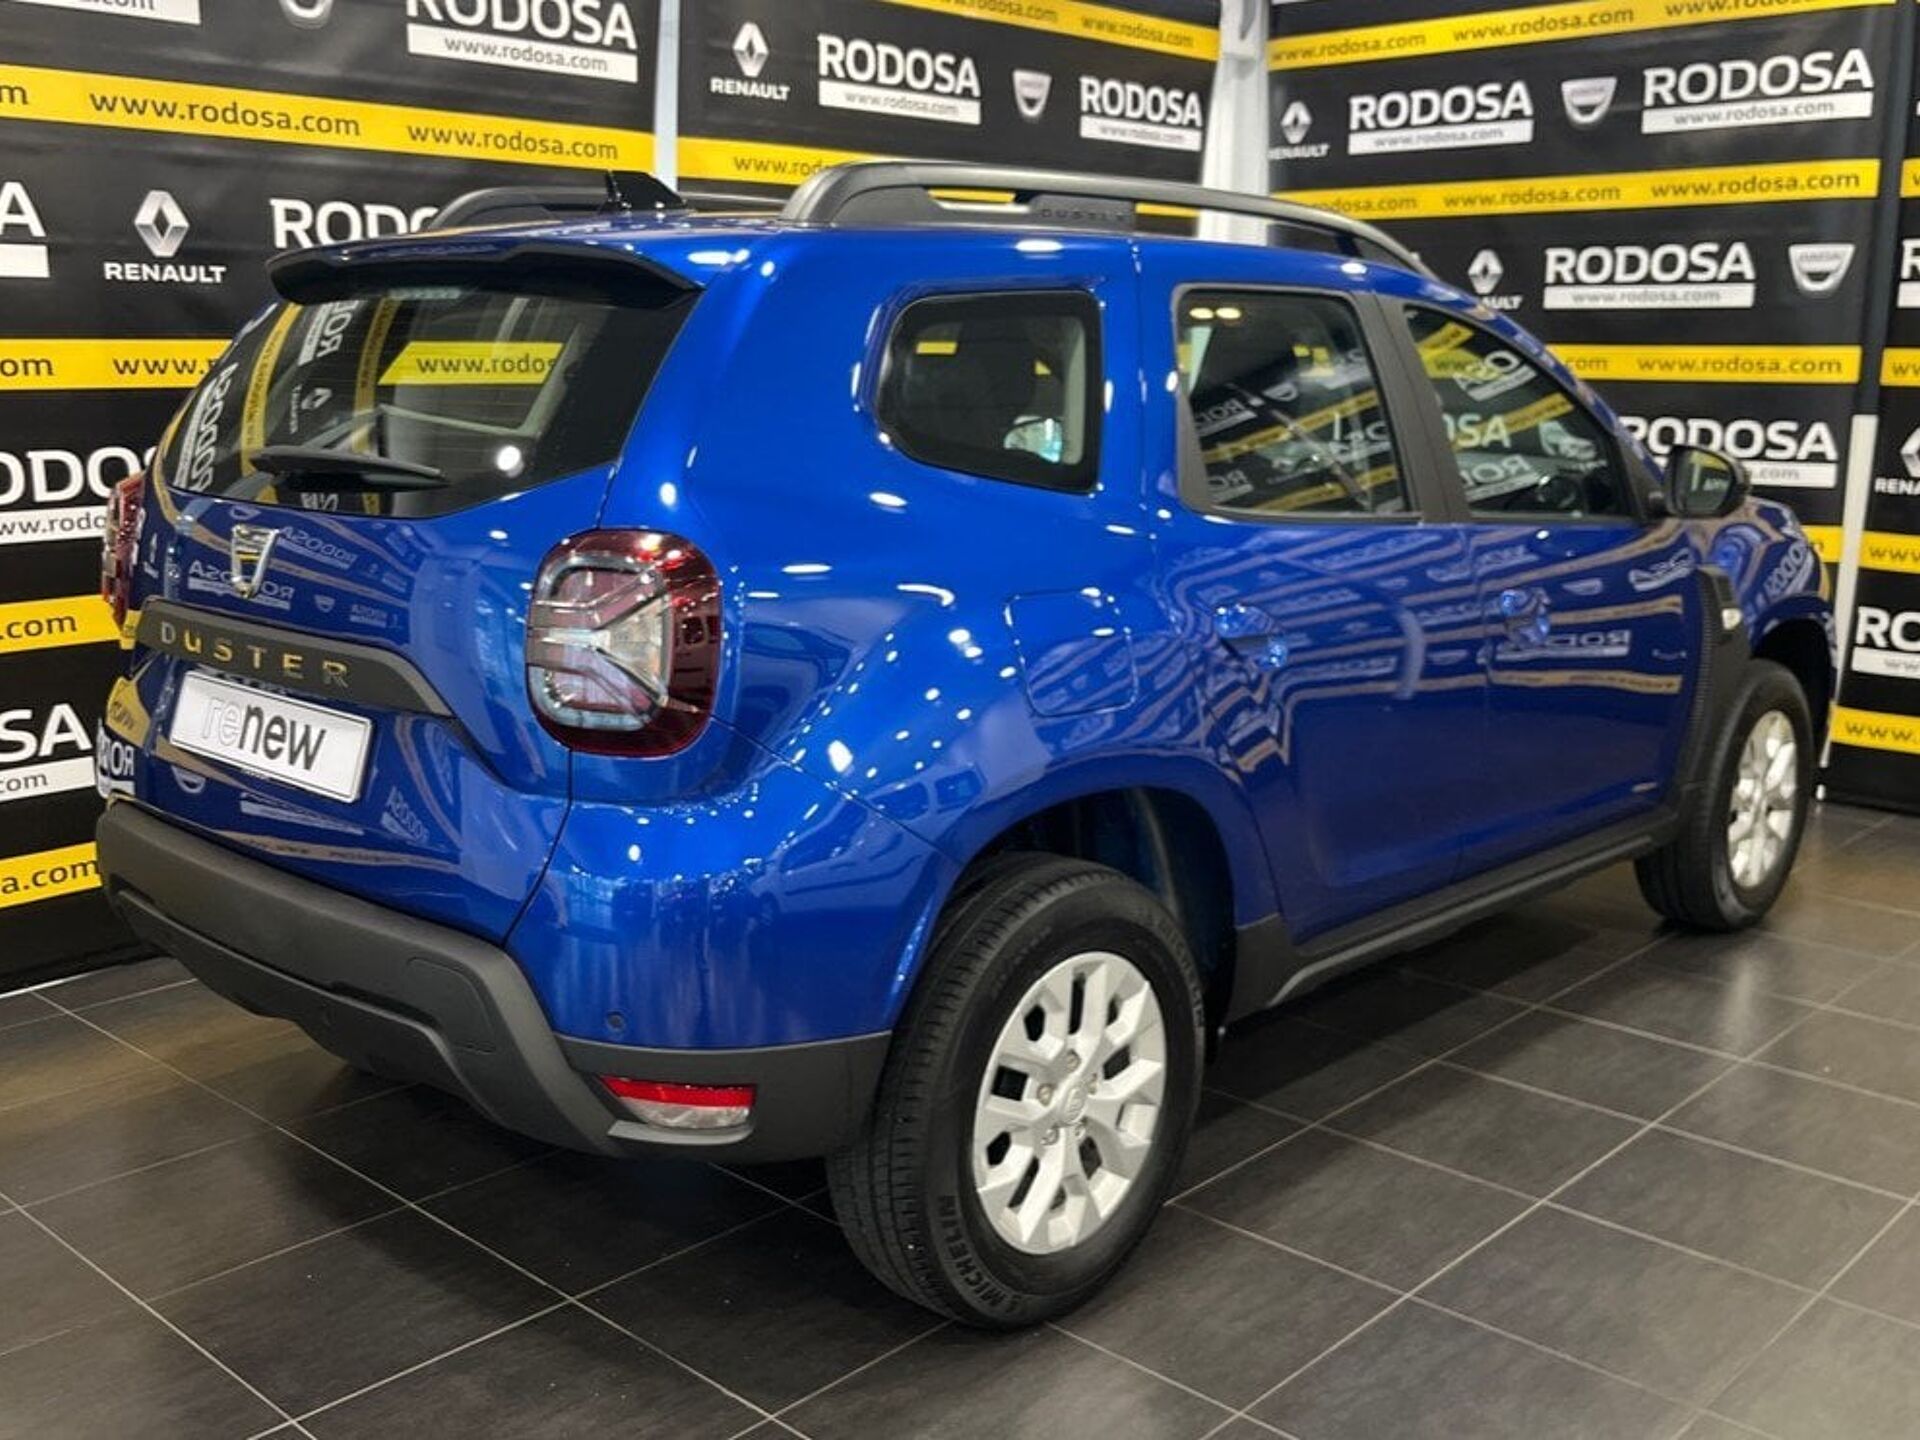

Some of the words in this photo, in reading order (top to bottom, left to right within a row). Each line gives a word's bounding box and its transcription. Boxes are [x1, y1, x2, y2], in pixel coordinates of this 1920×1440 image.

[1081, 15, 1195, 48] www.rodosa.com
[1453, 6, 1635, 43] www.rodosa.com
[444, 36, 609, 72] www.rodosa.com
[817, 33, 981, 98] RODOSA
[710, 77, 791, 101] RENAULT
[1643, 48, 1875, 108] RODOSA
[844, 91, 960, 117] www.rodosa.com
[1079, 75, 1203, 127] RODOSA
[1350, 81, 1535, 131] RODOSA
[1673, 100, 1836, 127] www.rodosa.com
[90, 92, 361, 138] www.rodosa.com
[407, 124, 619, 160] www.rodosa.com
[1374, 127, 1505, 149] www.rodosa.com
[1443, 185, 1622, 209] www.rodosa.com
[1650, 170, 1861, 199] www.rodosa.com
[104, 262, 228, 284] RENAULT
[1545, 241, 1756, 285] RODOSA
[1572, 288, 1721, 305] www.rodosa.com
[1637, 353, 1843, 374] www.rodosa.com
[1618, 415, 1838, 461] RODOSA
[161, 621, 349, 689] DUSTER
[202, 694, 327, 772] renew
[937, 1194, 1010, 1308] MICHELIN
